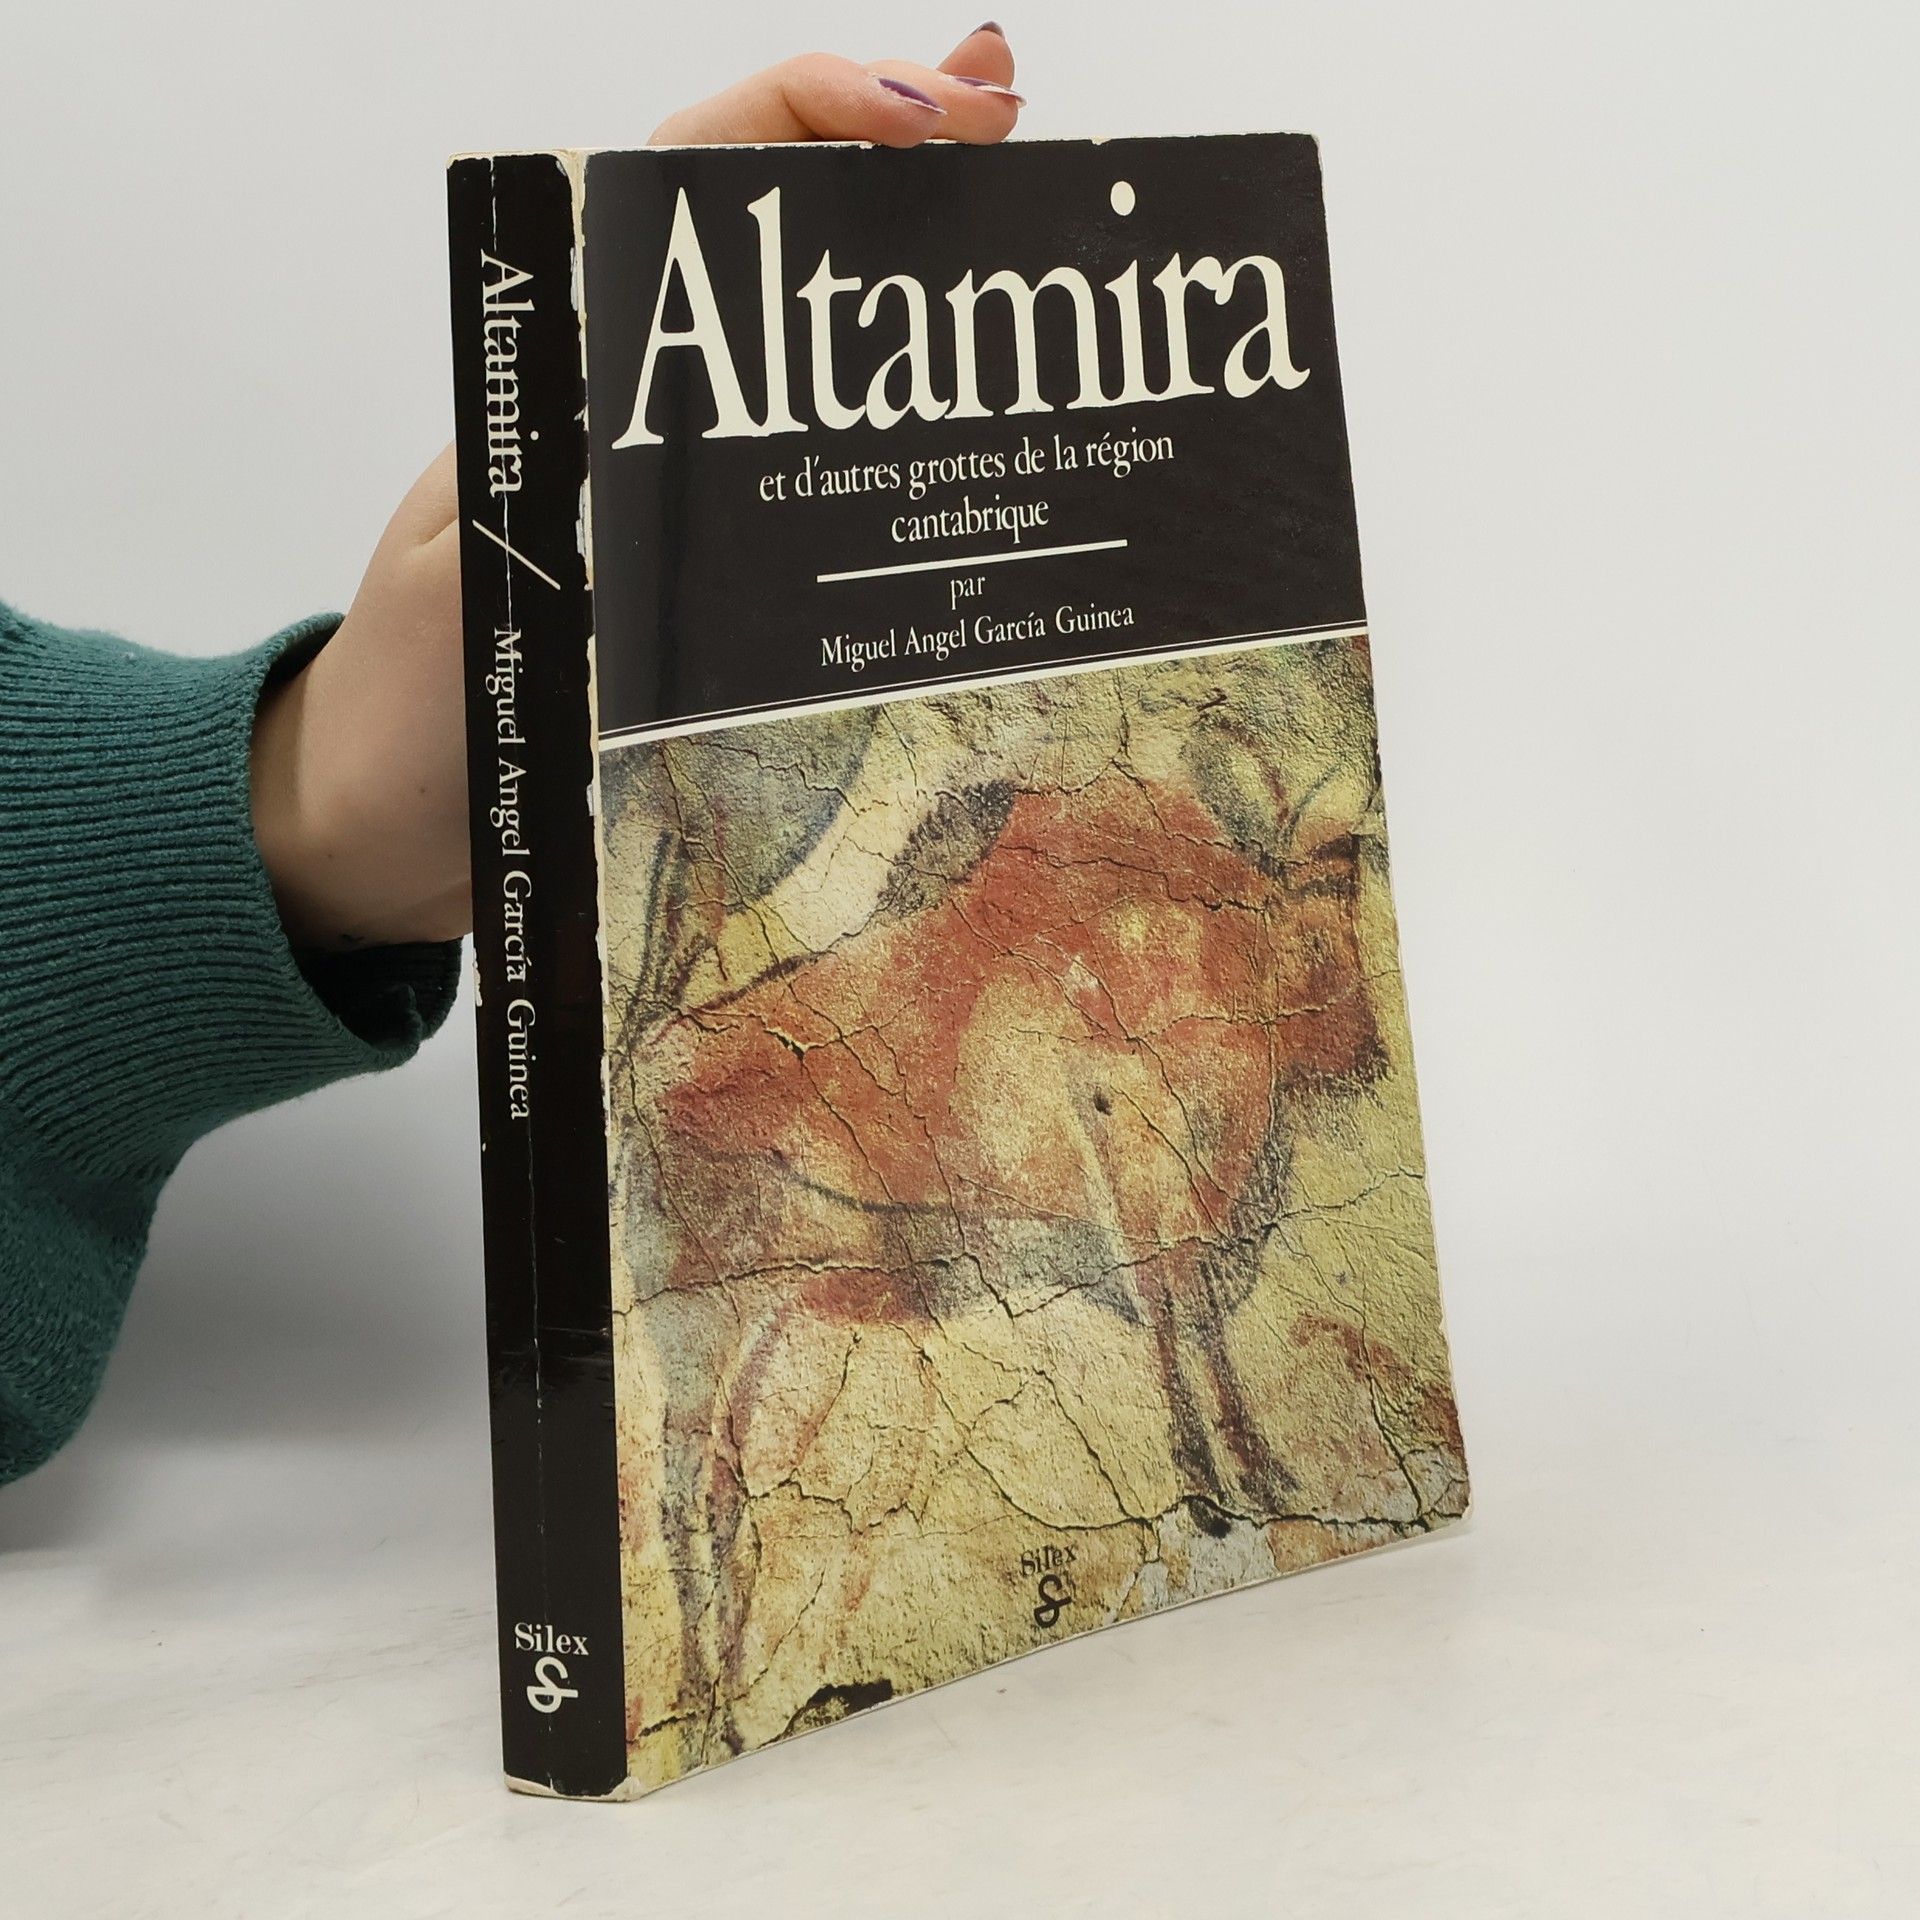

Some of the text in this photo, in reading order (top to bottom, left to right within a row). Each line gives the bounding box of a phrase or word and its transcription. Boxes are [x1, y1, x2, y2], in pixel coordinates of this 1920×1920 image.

[612, 181, 1310, 449] Altamira
[481, 248, 540, 498] Altamira
[760, 426, 1175, 502] et d'autres grottes de la région
[892, 494, 1049, 544] cantabrique
[951, 576, 986, 611] par
[822, 603, 1135, 673] Miguel Angel García Guinea
[486, 628, 537, 1120] Miguel Angel García Guinea
[1020, 1544, 1077, 1577] Silex
[514, 1622, 589, 1656] Silex
